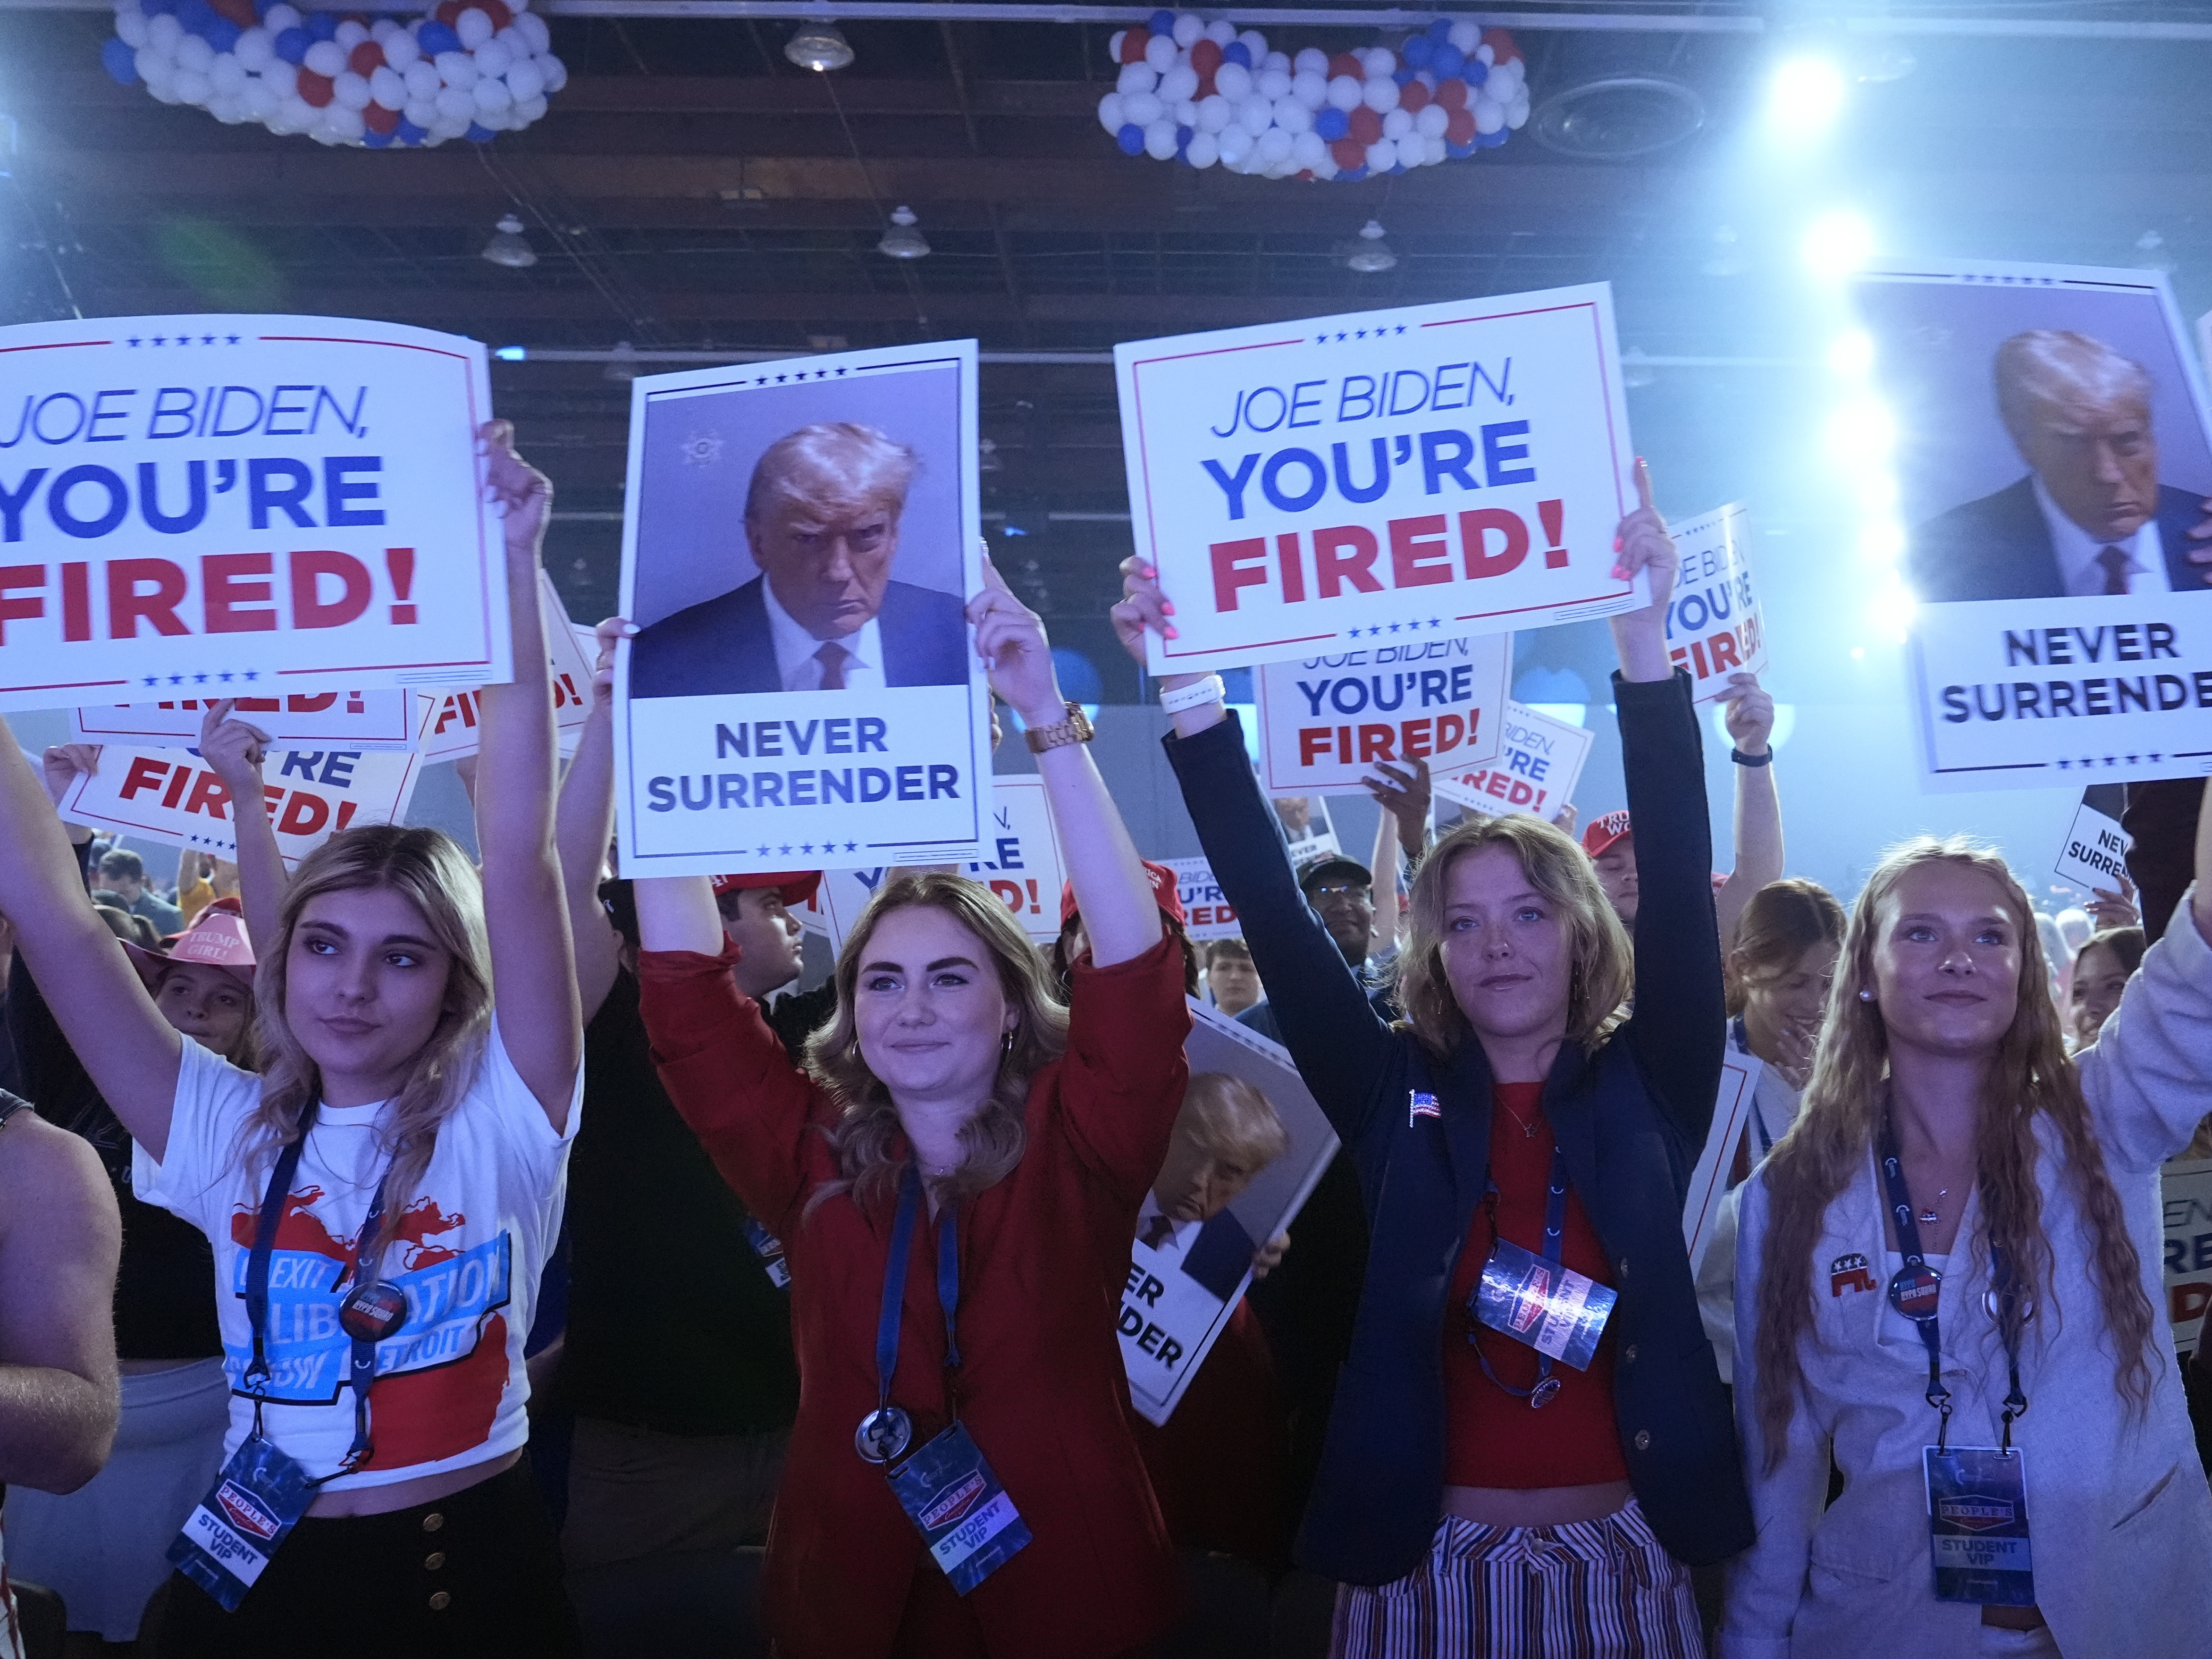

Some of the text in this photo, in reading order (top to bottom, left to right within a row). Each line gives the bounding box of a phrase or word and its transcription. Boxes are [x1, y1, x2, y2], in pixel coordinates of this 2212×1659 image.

[0, 385, 369, 448] JOE BIDEN,
[1209, 356, 1517, 438] JOE BIDEN,
[1200, 419, 1538, 521] YOU'RE
[0, 455, 386, 542] YOU'RE
[1208, 498, 1570, 614] FIRED!
[0, 547, 419, 647] FIRED!
[2002, 622, 2183, 667] NEVER
[1296, 664, 1473, 717] YOU'RE
[1940, 671, 2212, 724] SURRENDE
[715, 716, 889, 758] NEVER
[1299, 708, 1480, 767] FIRED!
[647, 764, 961, 812] SURRENDER
[1451, 770, 1548, 812] RED!
[2068, 842, 2133, 882] SURRE
[2098, 829, 2129, 857] NEV
[190, 931, 240, 949] TRUMP
[240, 1256, 330, 1288] EXIT
[270, 1252, 500, 1345] LIBATION
[376, 1324, 465, 1369] ETROIT
[220, 1486, 276, 1534] PEOPLE'S
[939, 1501, 1001, 1555] STUDENT
[198, 1514, 258, 1566] STUDENT
[210, 1536, 234, 1559] VIP
[964, 1527, 989, 1550] VIP
[1942, 1539, 2018, 1554] STUDENT
[1967, 1553, 1994, 1565] VIP
